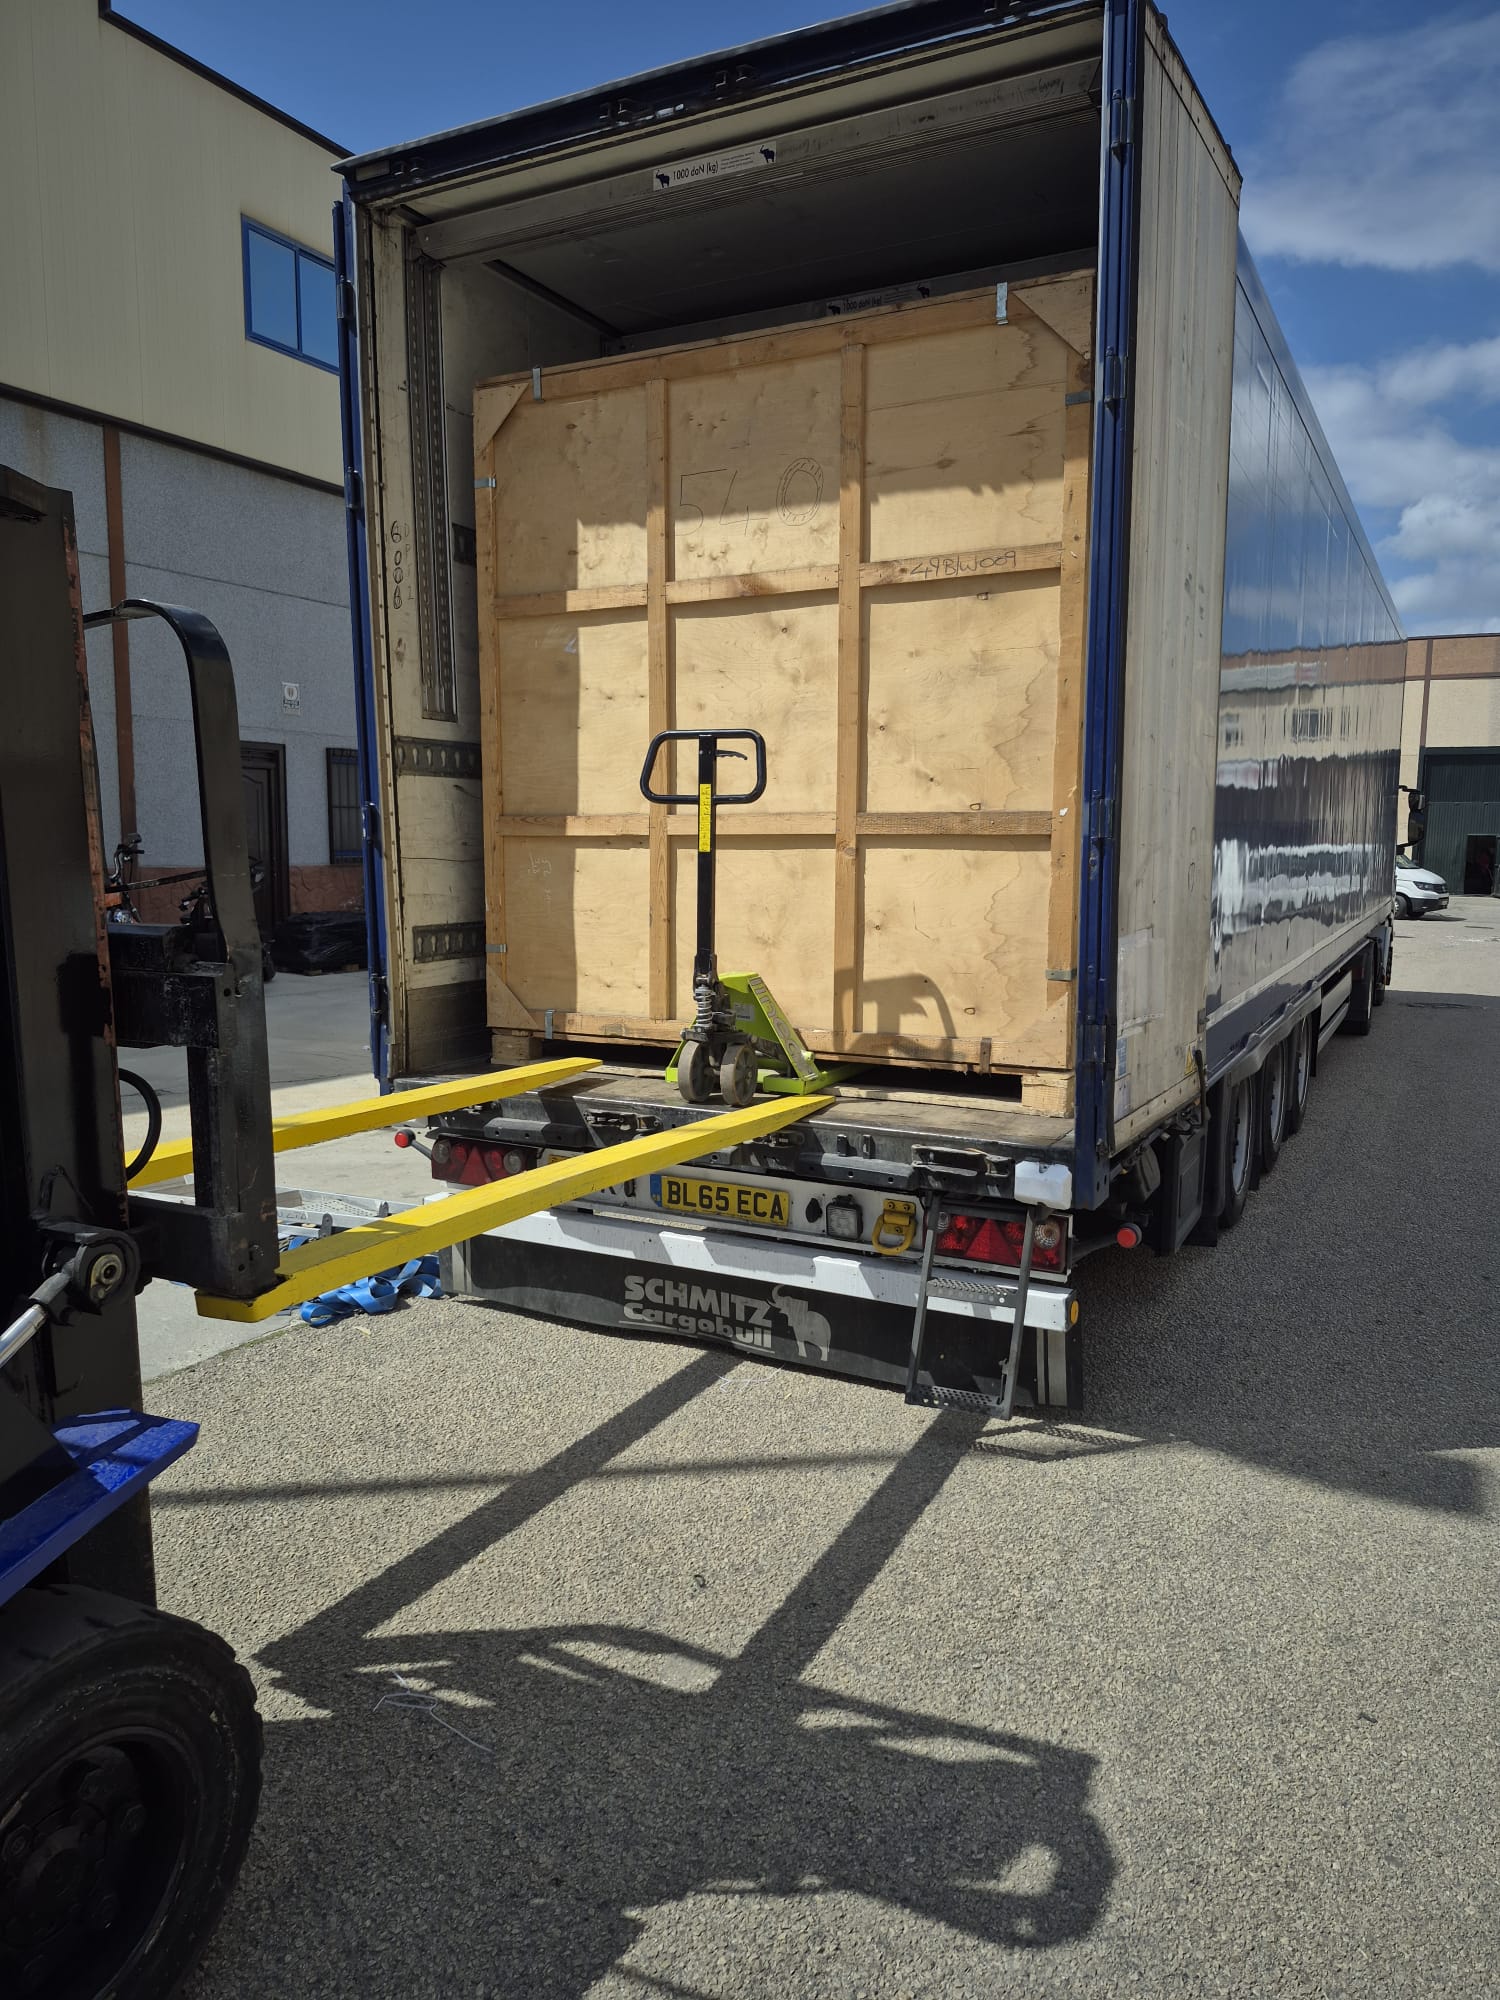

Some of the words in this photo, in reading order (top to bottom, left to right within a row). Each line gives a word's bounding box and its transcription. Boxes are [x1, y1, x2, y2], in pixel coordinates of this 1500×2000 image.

[673, 168, 690, 181] 1000
[667, 1181, 730, 1211] BL65
[737, 1189, 784, 1221] ECA
[624, 1275, 772, 1328] SCHMITZ
[623, 1302, 772, 1348] Cargobull
